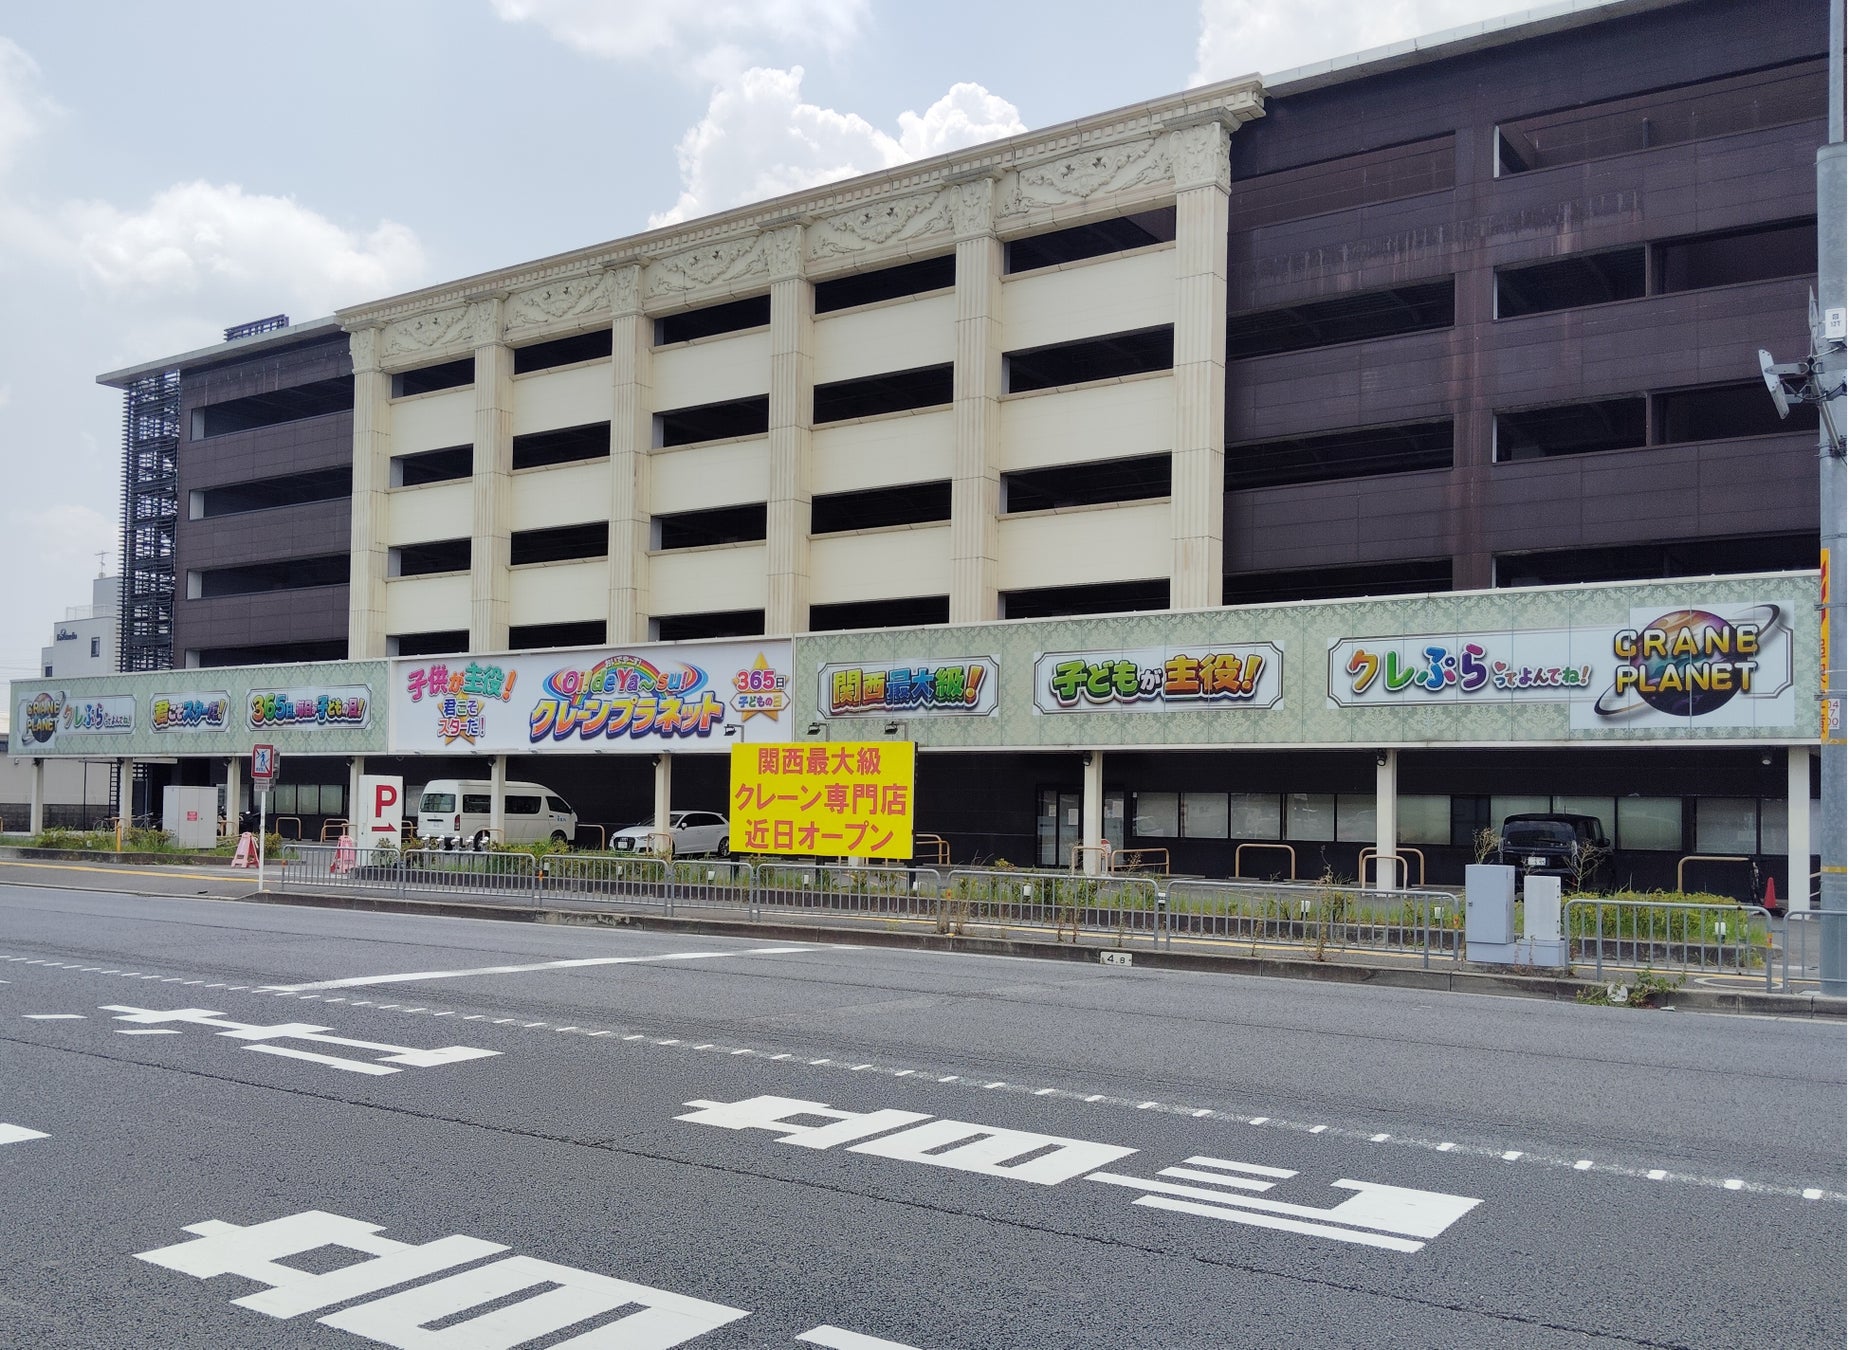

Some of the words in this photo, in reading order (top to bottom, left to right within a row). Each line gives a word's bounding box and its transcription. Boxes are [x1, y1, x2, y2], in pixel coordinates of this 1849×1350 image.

[1614, 624, 1760, 658] CRANE
[408, 662, 517, 702] 子供が主役!
[735, 669, 786, 691] 365日
[831, 664, 985, 708] 関西最大級!
[1052, 653, 1264, 704] 子どもが主役!
[1616, 661, 1758, 693] PLANET
[27, 701, 60, 716] CRANE
[444, 698, 478, 717] 君こそ
[530, 691, 725, 743] クレーンプラネット
[739, 696, 783, 708] 子どもの日
[26, 717, 59, 733] PLANET
[437, 717, 486, 737] スターだ!
[758, 746, 881, 776] 関西最大級
[375, 784, 398, 818] P
[735, 782, 908, 816] クレーン専門店
[745, 818, 895, 852] 近日オープン
